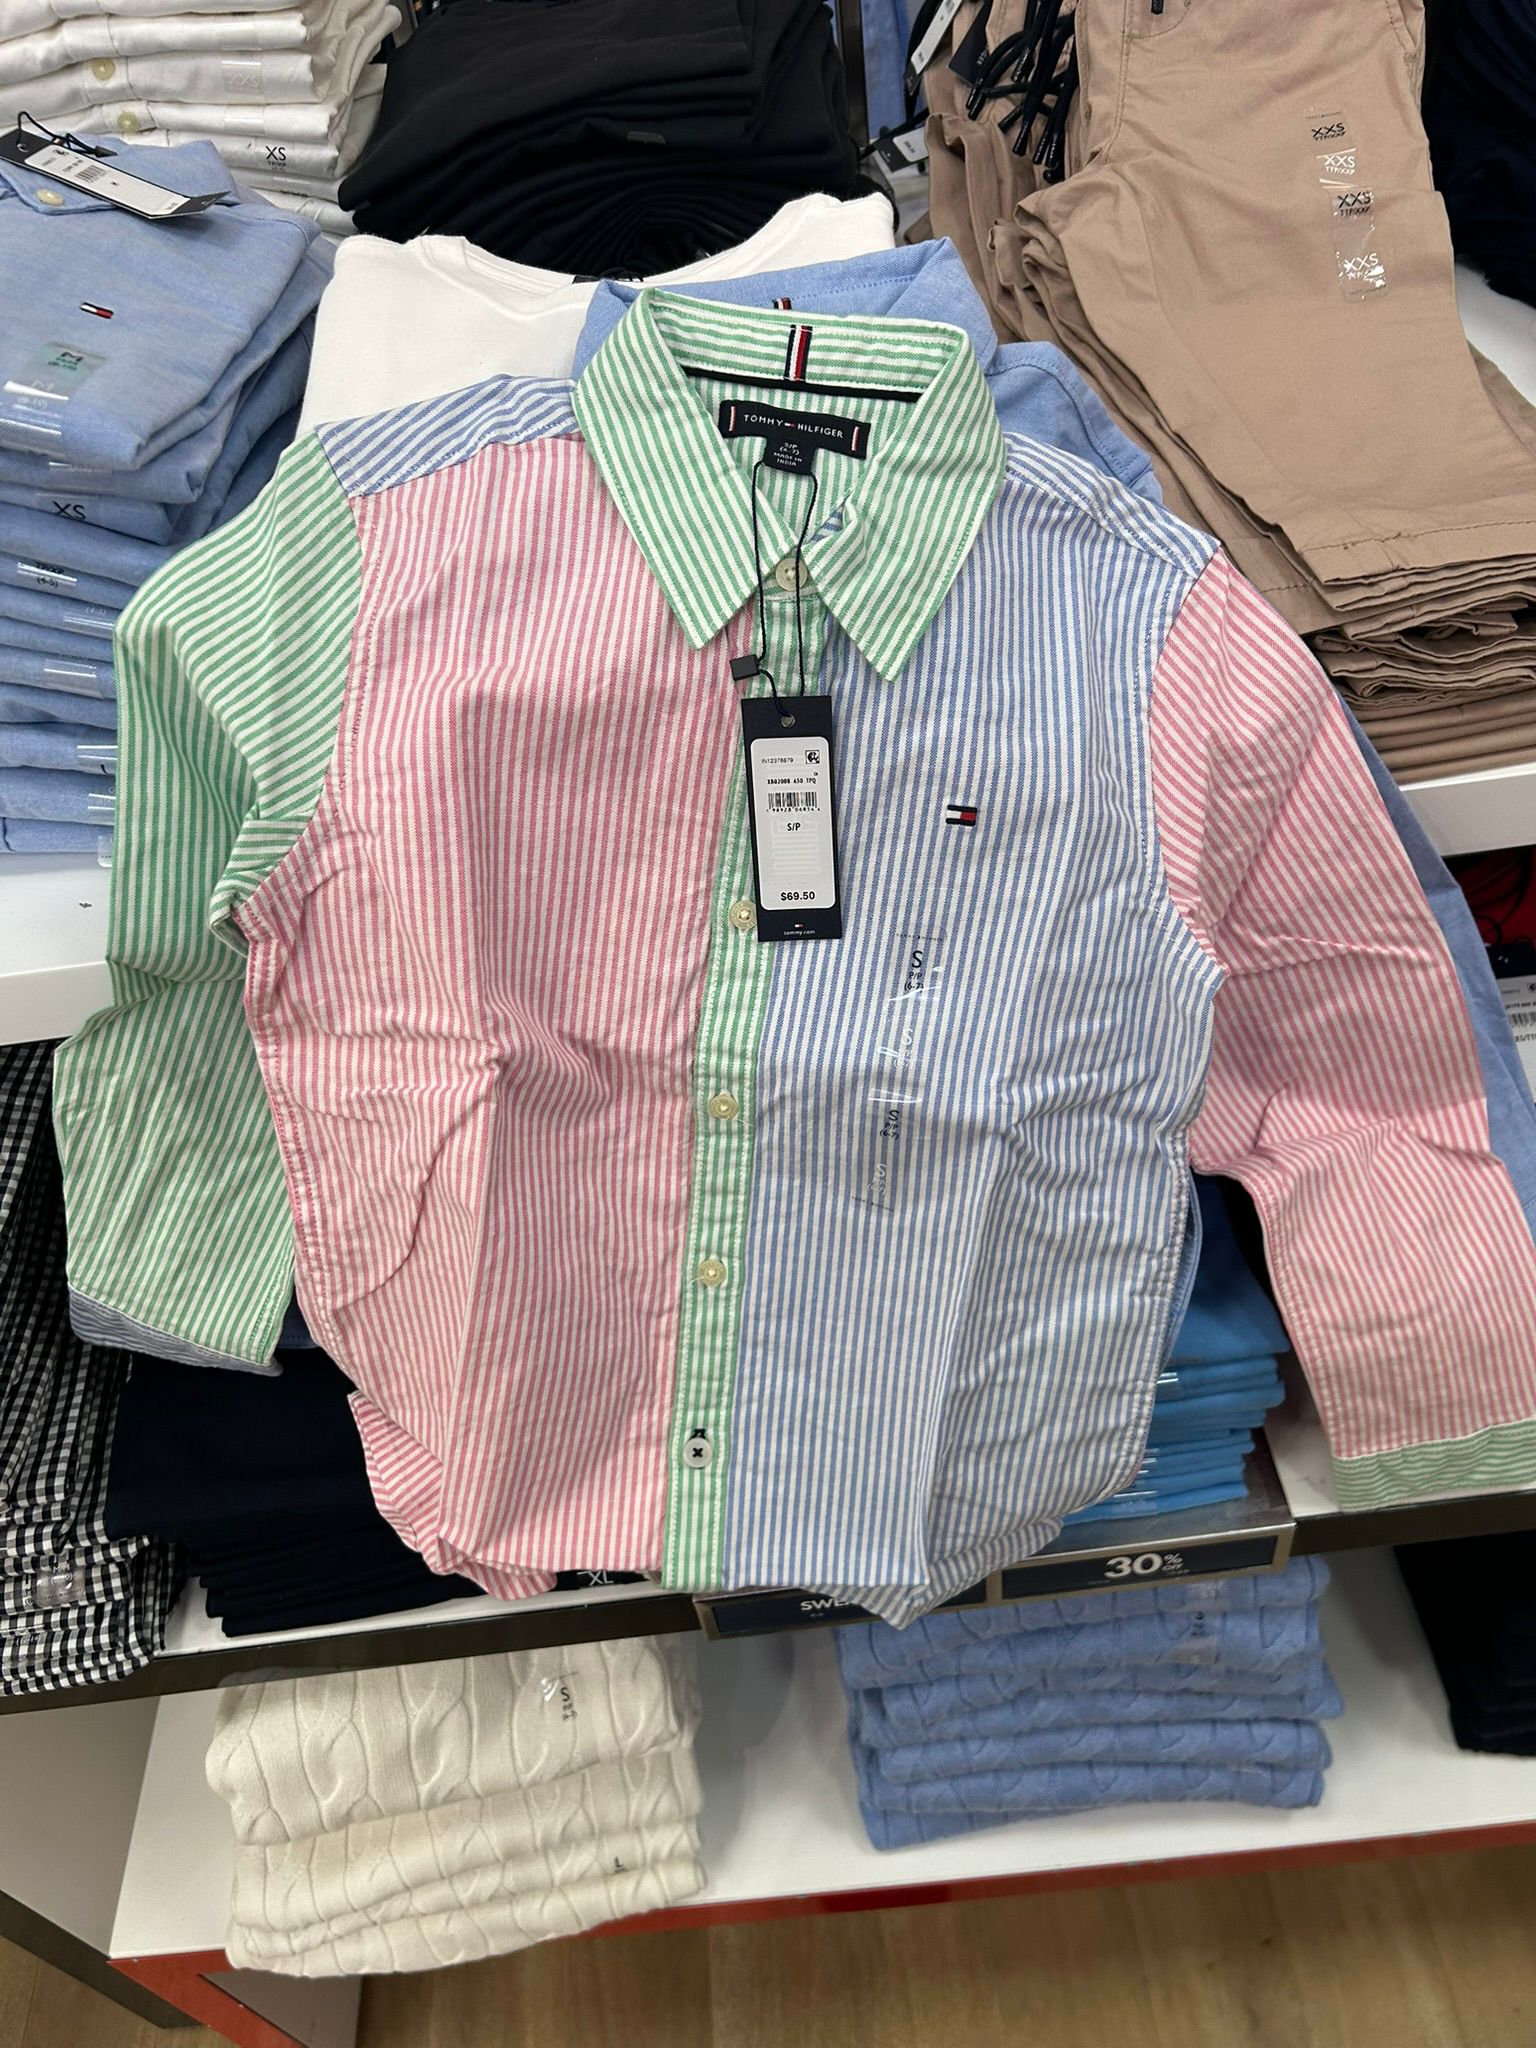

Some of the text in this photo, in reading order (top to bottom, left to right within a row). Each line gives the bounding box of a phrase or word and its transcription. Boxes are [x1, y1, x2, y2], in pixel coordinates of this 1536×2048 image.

[1311, 122, 1345, 138] XXS
[265, 145, 287, 161] XS
[1324, 154, 1356, 168] XXS
[1337, 190, 1372, 209] XXS
[1343, 253, 1379, 273] XXS
[743, 414, 844, 439] TOMMY HILFIGER
[776, 458, 797, 467] INDIA
[53, 501, 86, 520] XS
[787, 822, 801, 831] S/P
[780, 891, 816, 901] $69.50
[783, 929, 816, 937] tommy.com
[912, 950, 923, 968] S
[909, 972, 923, 980] P/P
[888, 1109, 900, 1121] S
[876, 1163, 888, 1178] S
[587, 1570, 614, 1586] XL
[561, 1686, 571, 1702] S
[614, 1856, 624, 1869] L
